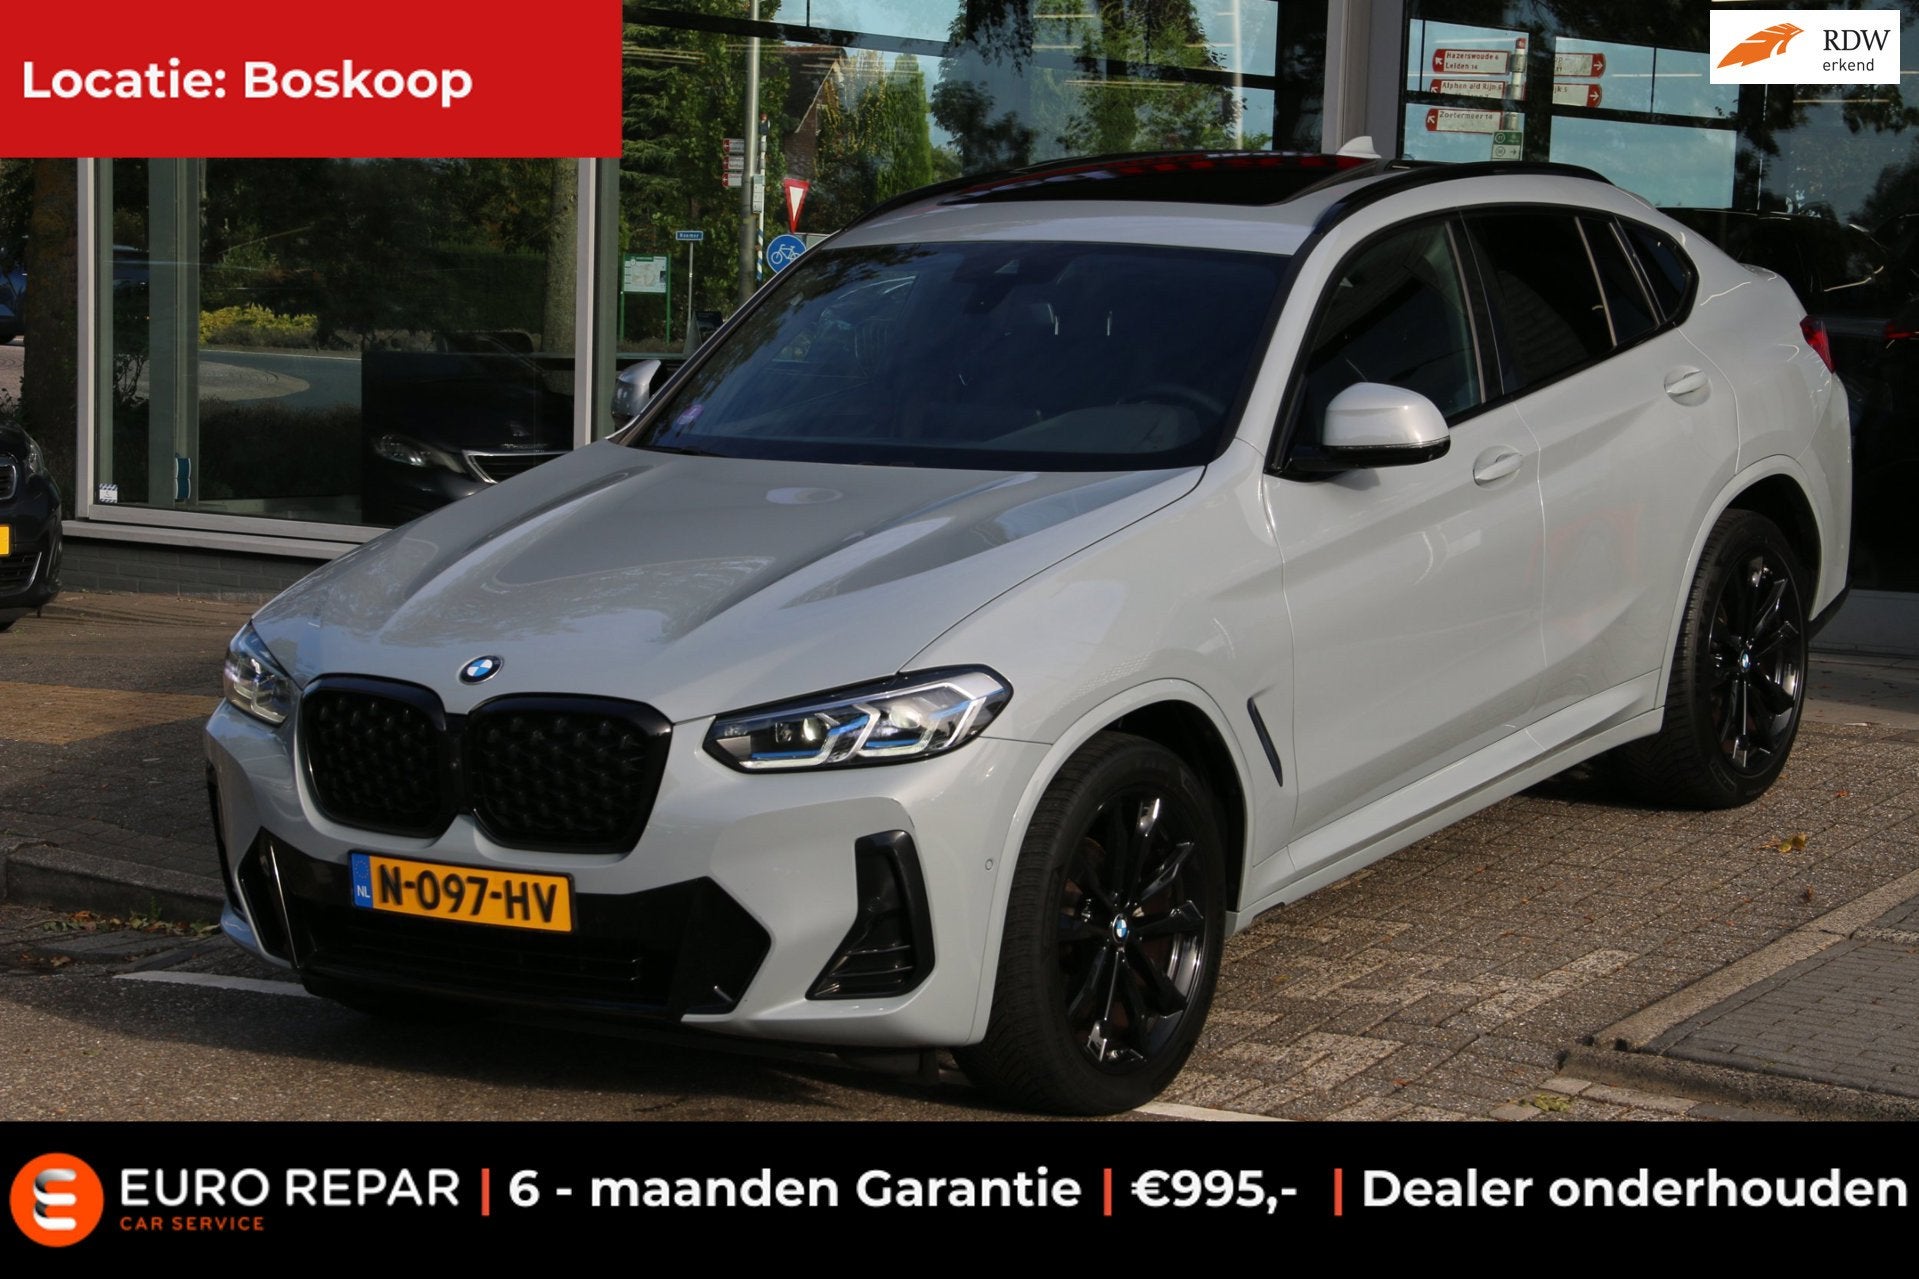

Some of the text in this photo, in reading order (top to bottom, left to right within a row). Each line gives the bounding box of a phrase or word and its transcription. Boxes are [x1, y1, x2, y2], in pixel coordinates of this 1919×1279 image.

[1446, 52, 1495, 60] Hazerswoude
[1442, 81, 1467, 90] Alphen
[1439, 111, 1483, 120] Zoetermeer
[357, 884, 371, 898] NL
[379, 863, 558, 923] N-097-HV
